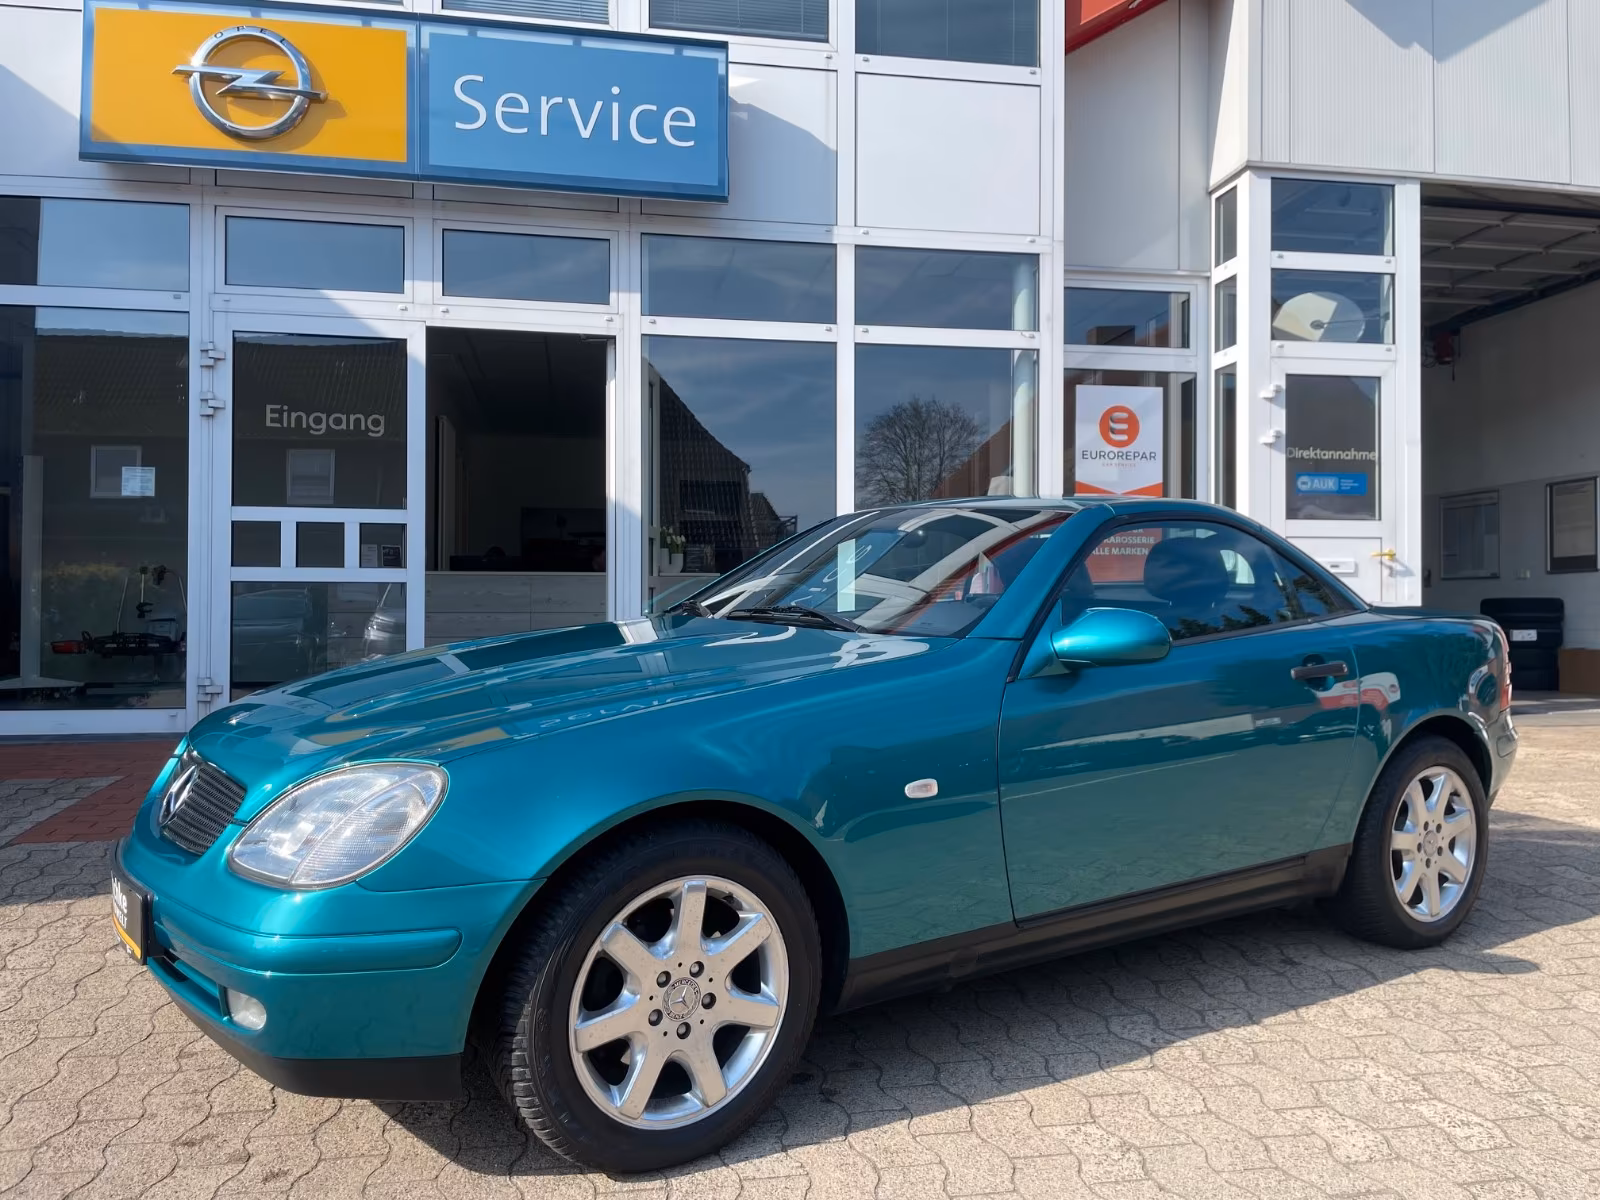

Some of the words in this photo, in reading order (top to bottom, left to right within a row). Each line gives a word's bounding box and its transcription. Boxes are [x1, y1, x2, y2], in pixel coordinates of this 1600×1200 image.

[214, 25, 287, 46] OPEL
[453, 74, 696, 147] Service
[265, 404, 385, 437] Eingang
[1081, 450, 1157, 461] EUROREPAR
[1287, 447, 1378, 460] Direktannahme
[1111, 547, 1149, 555] MARKEN
